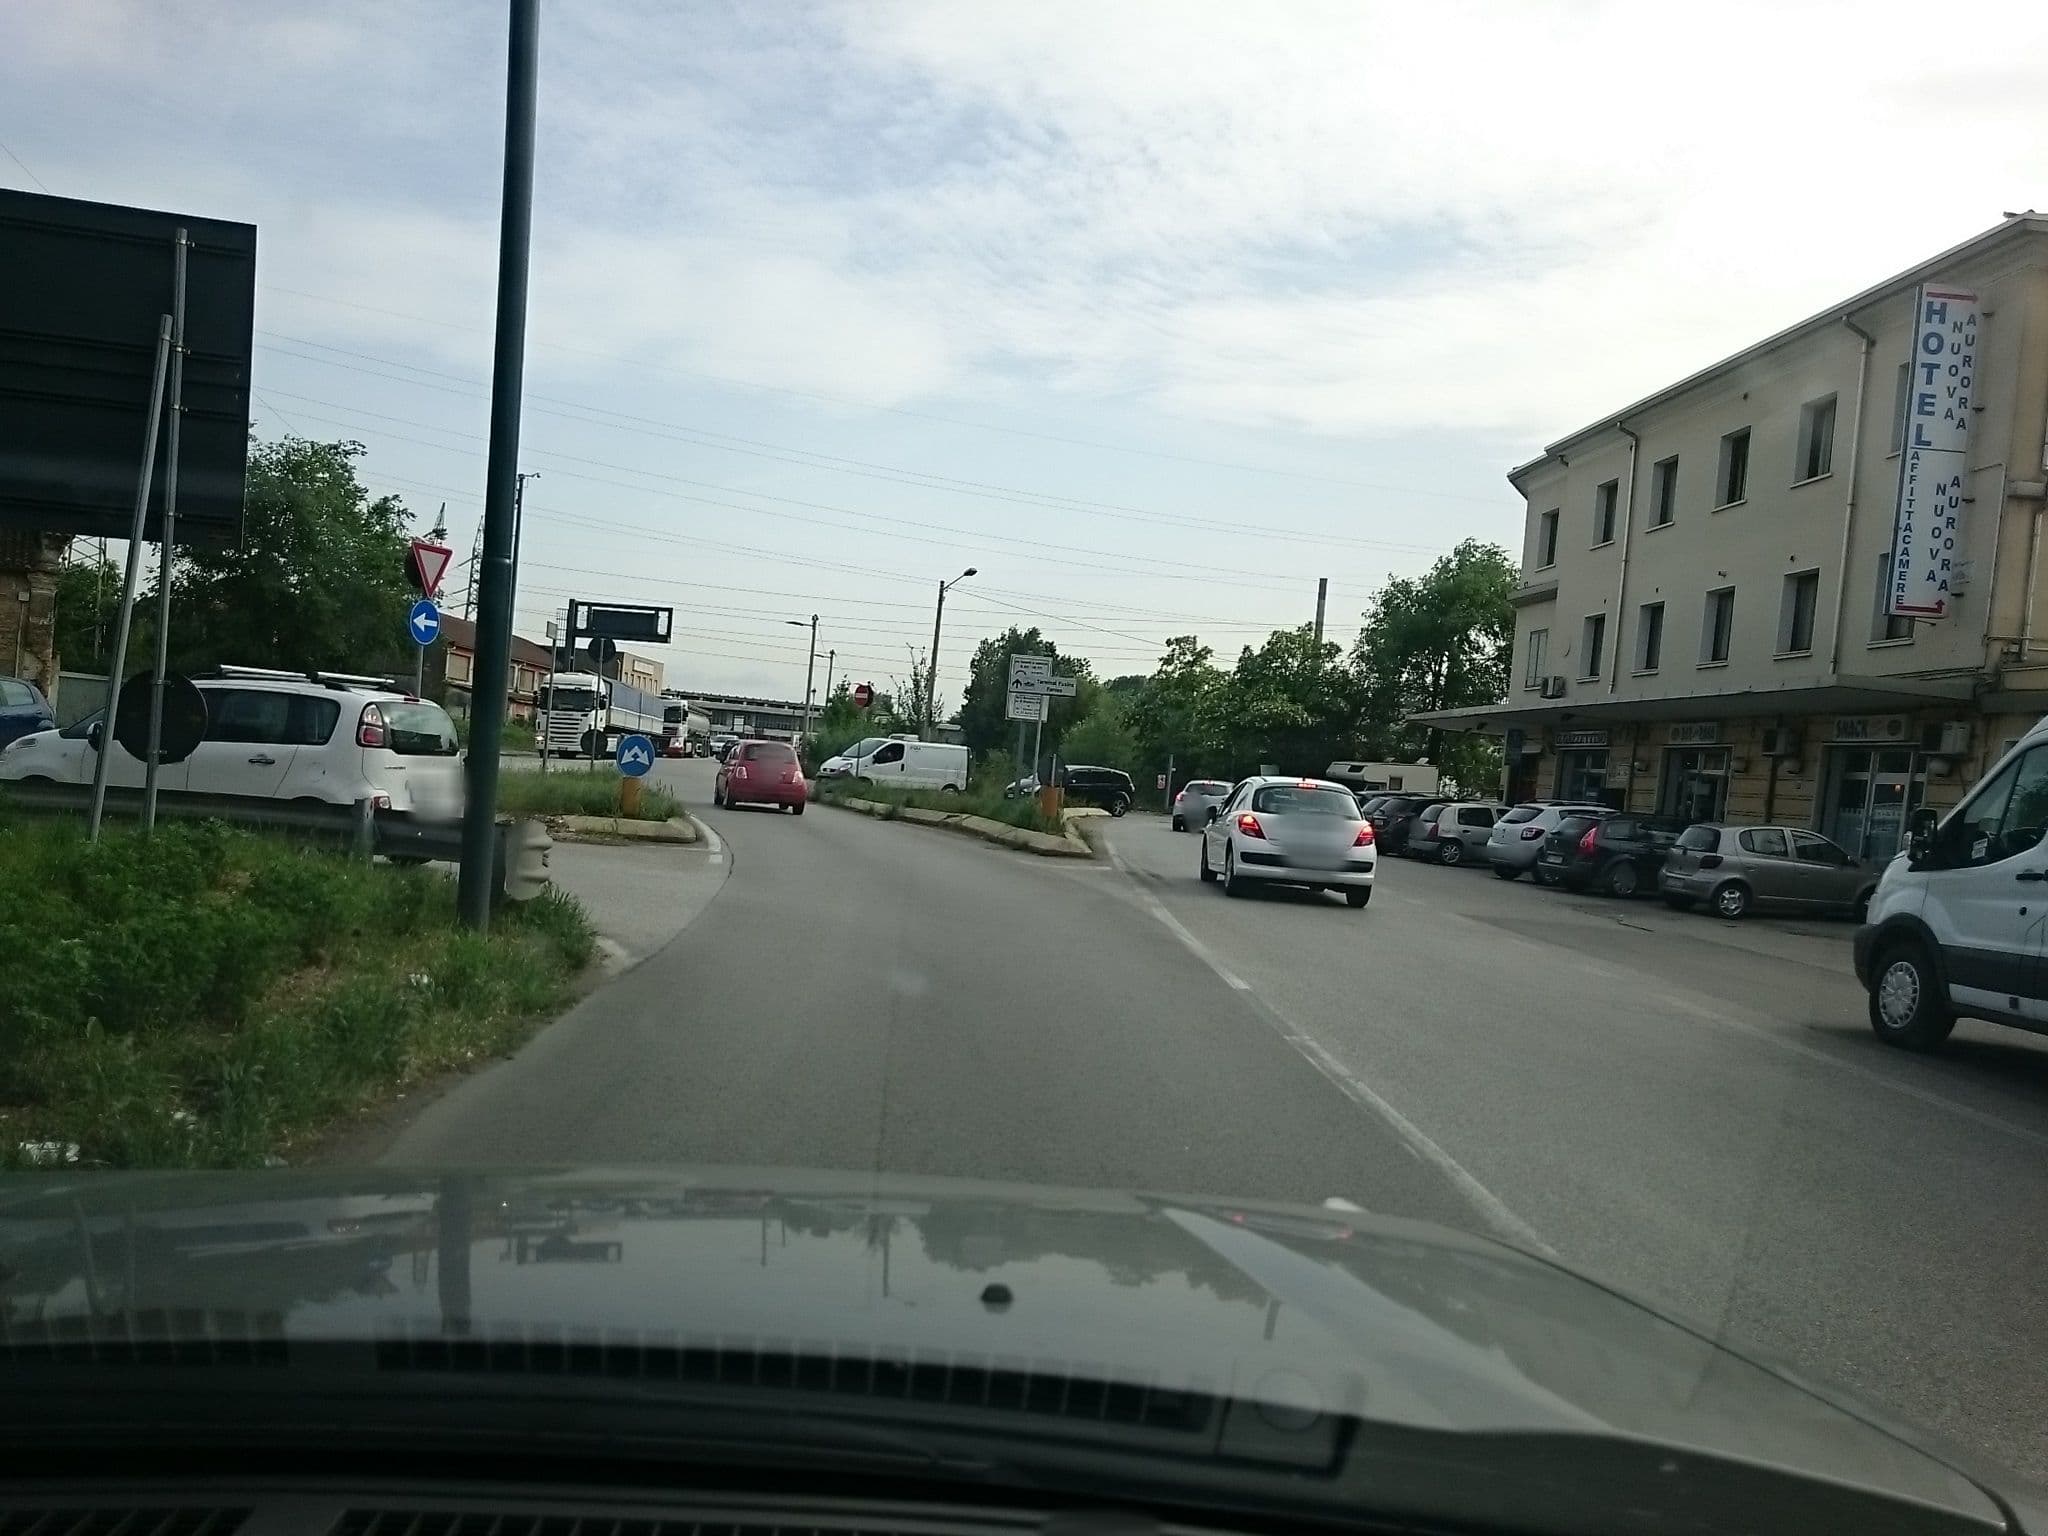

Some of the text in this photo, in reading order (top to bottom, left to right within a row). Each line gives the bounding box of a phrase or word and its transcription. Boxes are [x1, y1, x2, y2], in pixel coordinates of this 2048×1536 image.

[1914, 301, 1948, 447] HOTEL
[1944, 313, 1976, 431] NUOVA AURORA
[1895, 450, 1920, 605] AFFITTACAMERE
[1925, 475, 1961, 593] NUOVA AURORA
